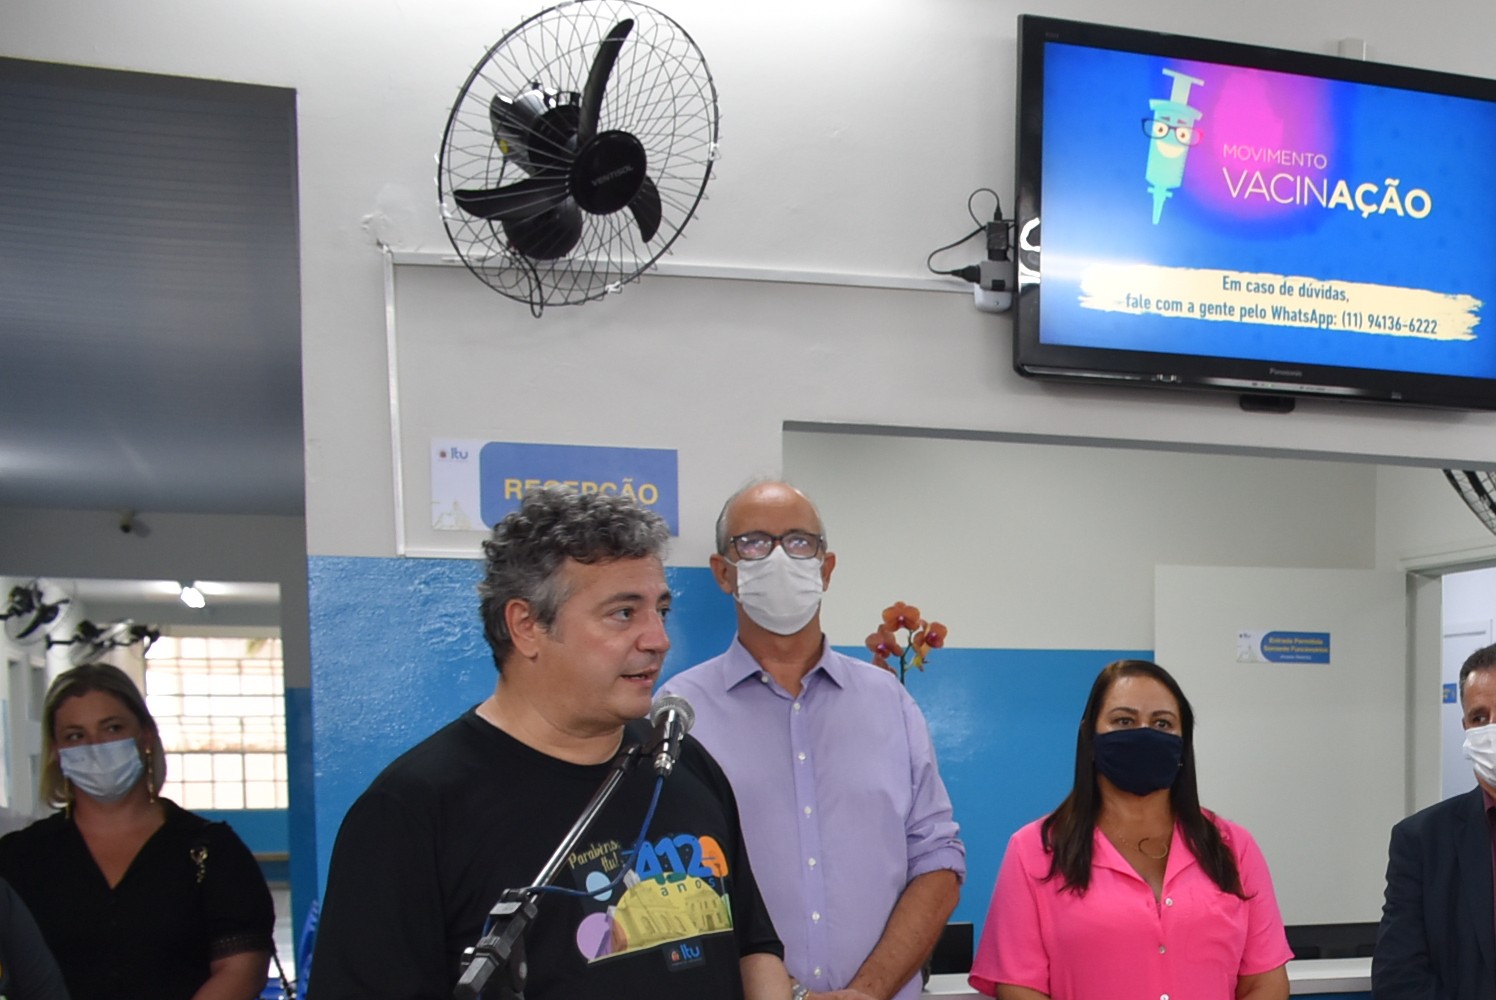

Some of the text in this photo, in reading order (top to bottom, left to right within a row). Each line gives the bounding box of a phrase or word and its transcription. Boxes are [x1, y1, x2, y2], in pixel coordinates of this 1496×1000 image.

[1222, 143, 1328, 171] MOVIMENTO
[591, 165, 634, 187] VENTISOL
[1221, 166, 1433, 220] VACINAÇÃO
[1222, 275, 1350, 303] Em caso de dúvidas,
[1125, 292, 1438, 335] fale com a gente pelo WhatsApp: (11) 94136-6222
[450, 446, 469, 460] Itu
[634, 833, 713, 885] 412
[660, 878, 717, 897] anos
[679, 943, 701, 961] Itu
